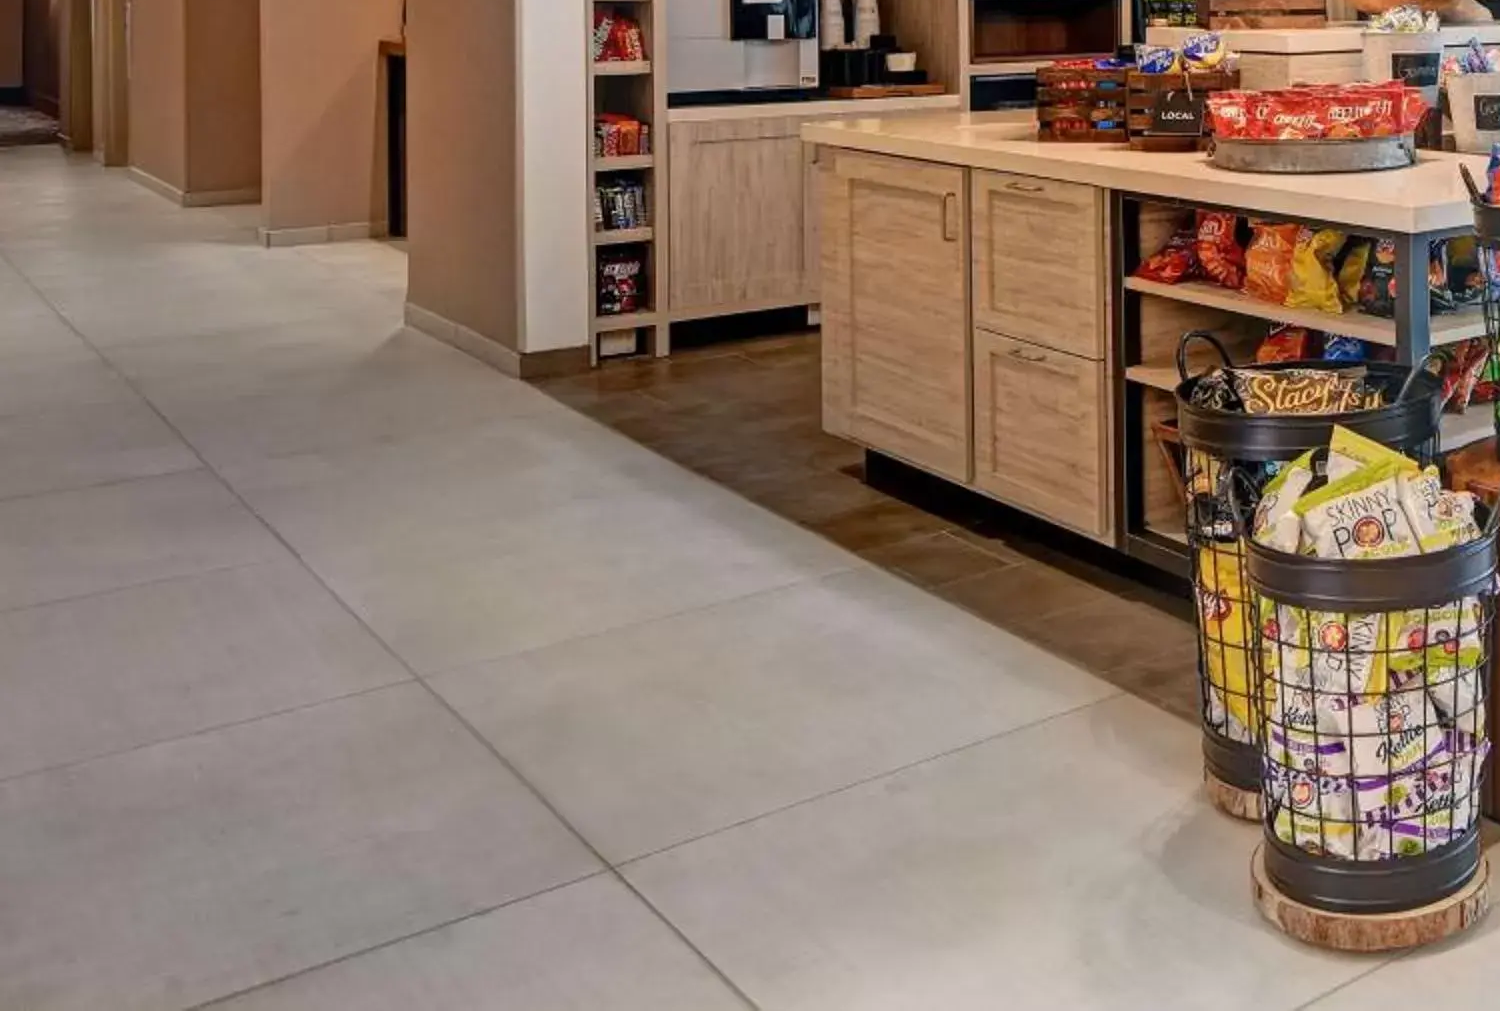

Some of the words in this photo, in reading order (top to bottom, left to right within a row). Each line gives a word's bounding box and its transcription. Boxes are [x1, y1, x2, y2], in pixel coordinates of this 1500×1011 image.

[1160, 111, 1195, 121] LOCAL
[1249, 372, 1332, 414] Stacy
[1326, 488, 1392, 528] SKINNY
